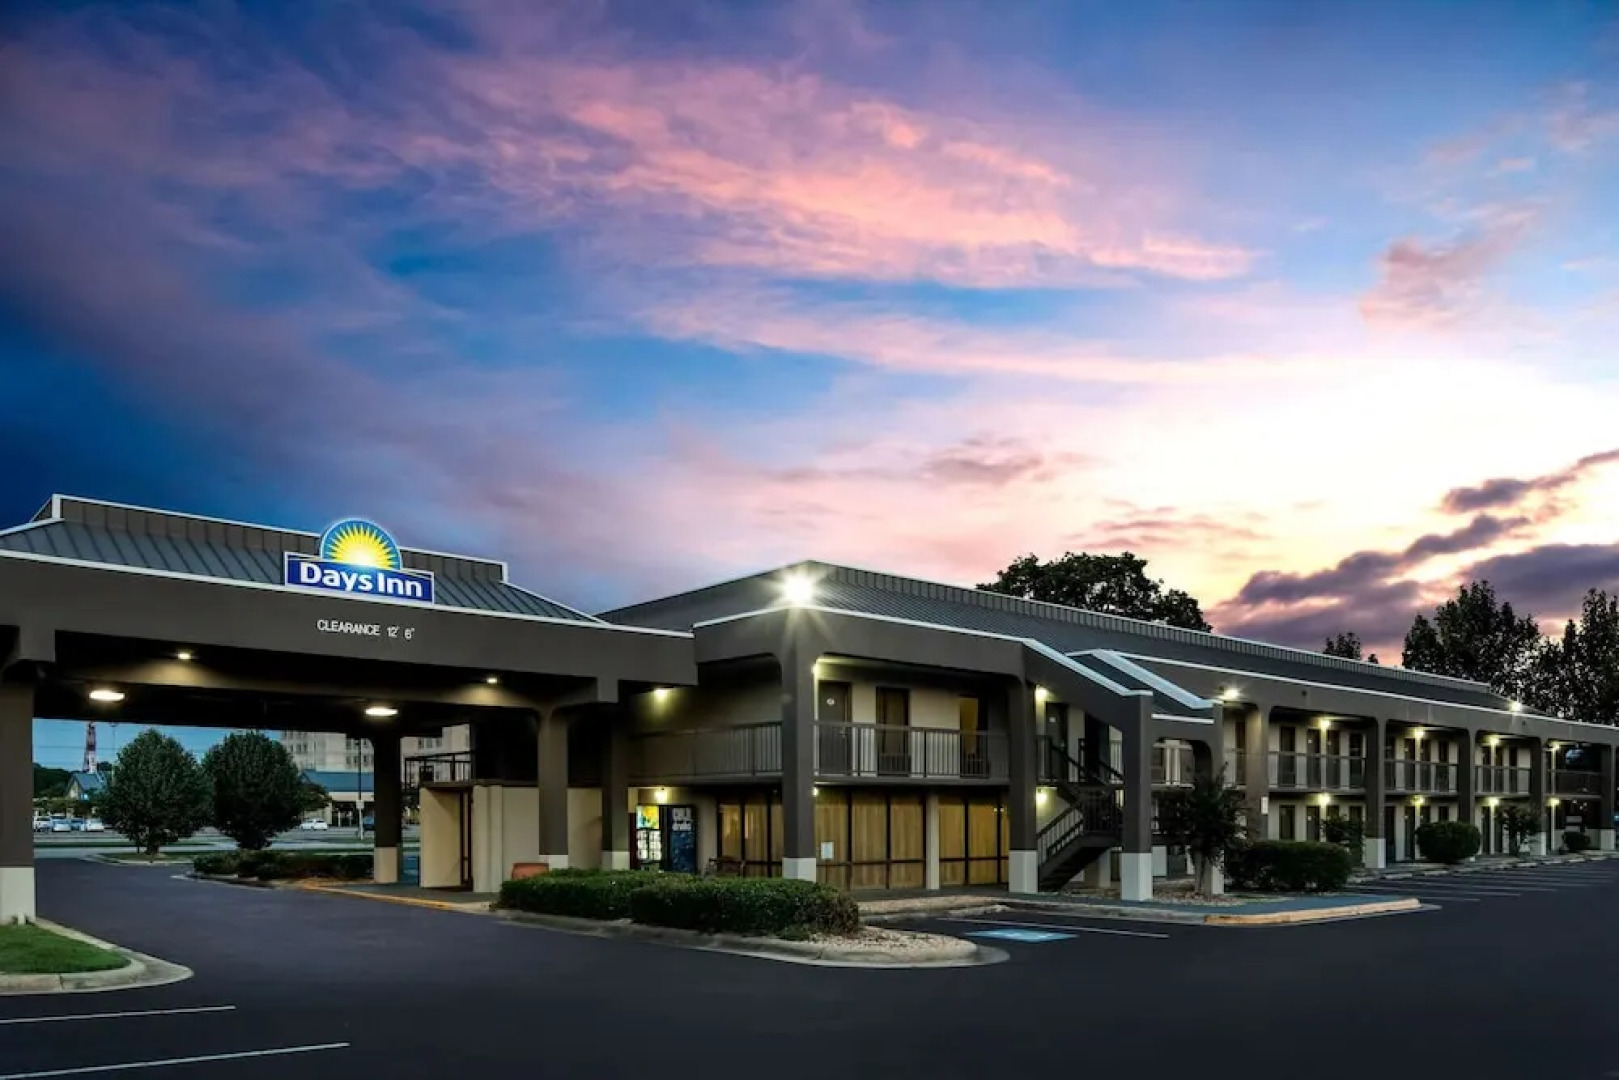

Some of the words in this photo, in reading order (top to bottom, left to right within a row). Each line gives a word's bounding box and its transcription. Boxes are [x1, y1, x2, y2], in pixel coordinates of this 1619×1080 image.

[300, 562, 373, 592] Days
[377, 572, 422, 597] Inn
[317, 620, 380, 636] CLEARANCE
